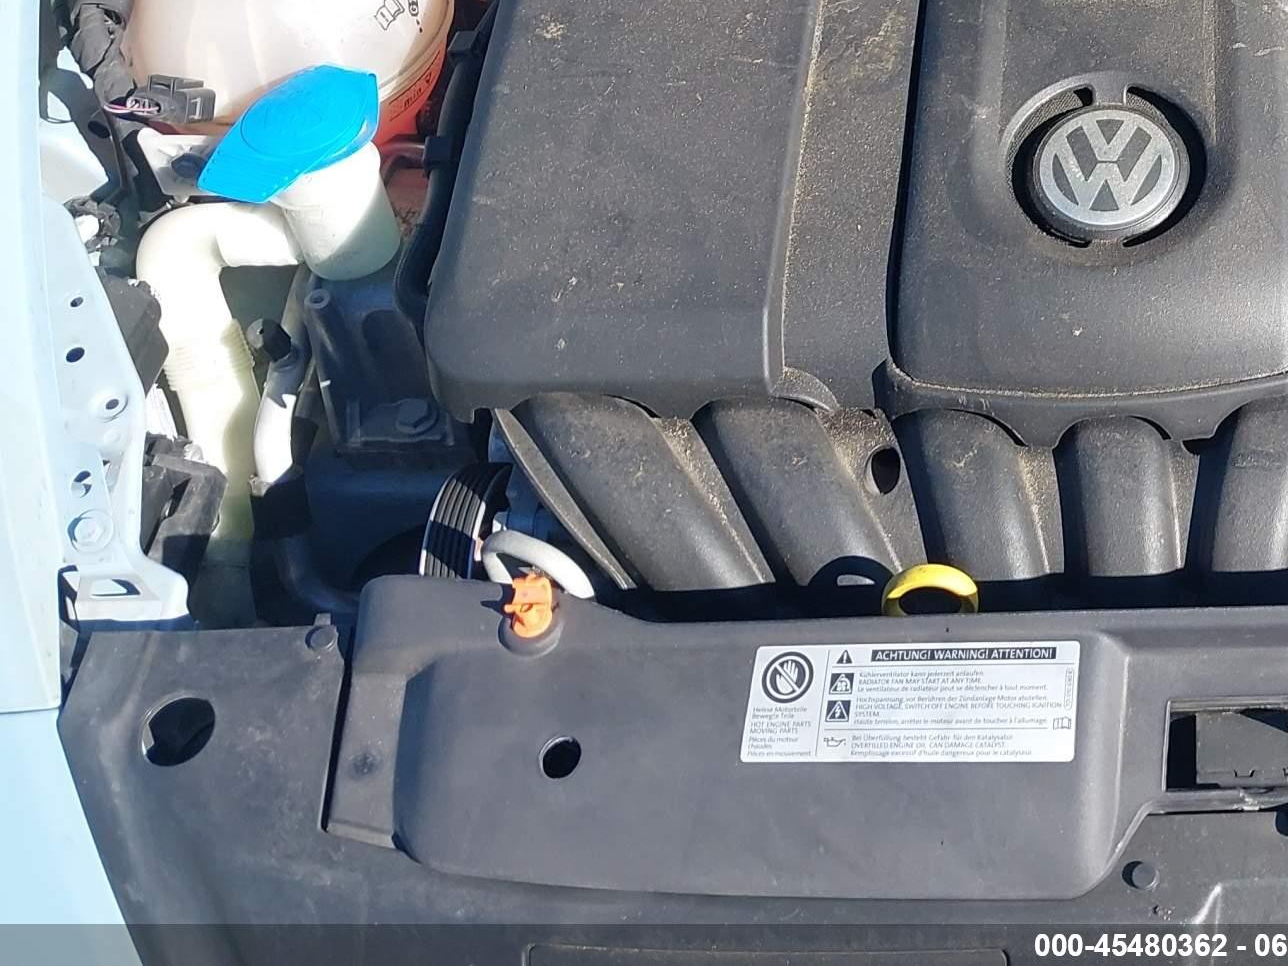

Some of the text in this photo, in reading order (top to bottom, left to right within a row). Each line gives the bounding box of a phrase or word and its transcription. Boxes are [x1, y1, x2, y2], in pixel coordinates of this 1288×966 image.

[876, 648, 1053, 661] ACHTUNG! WARNING! ATTENTION!
